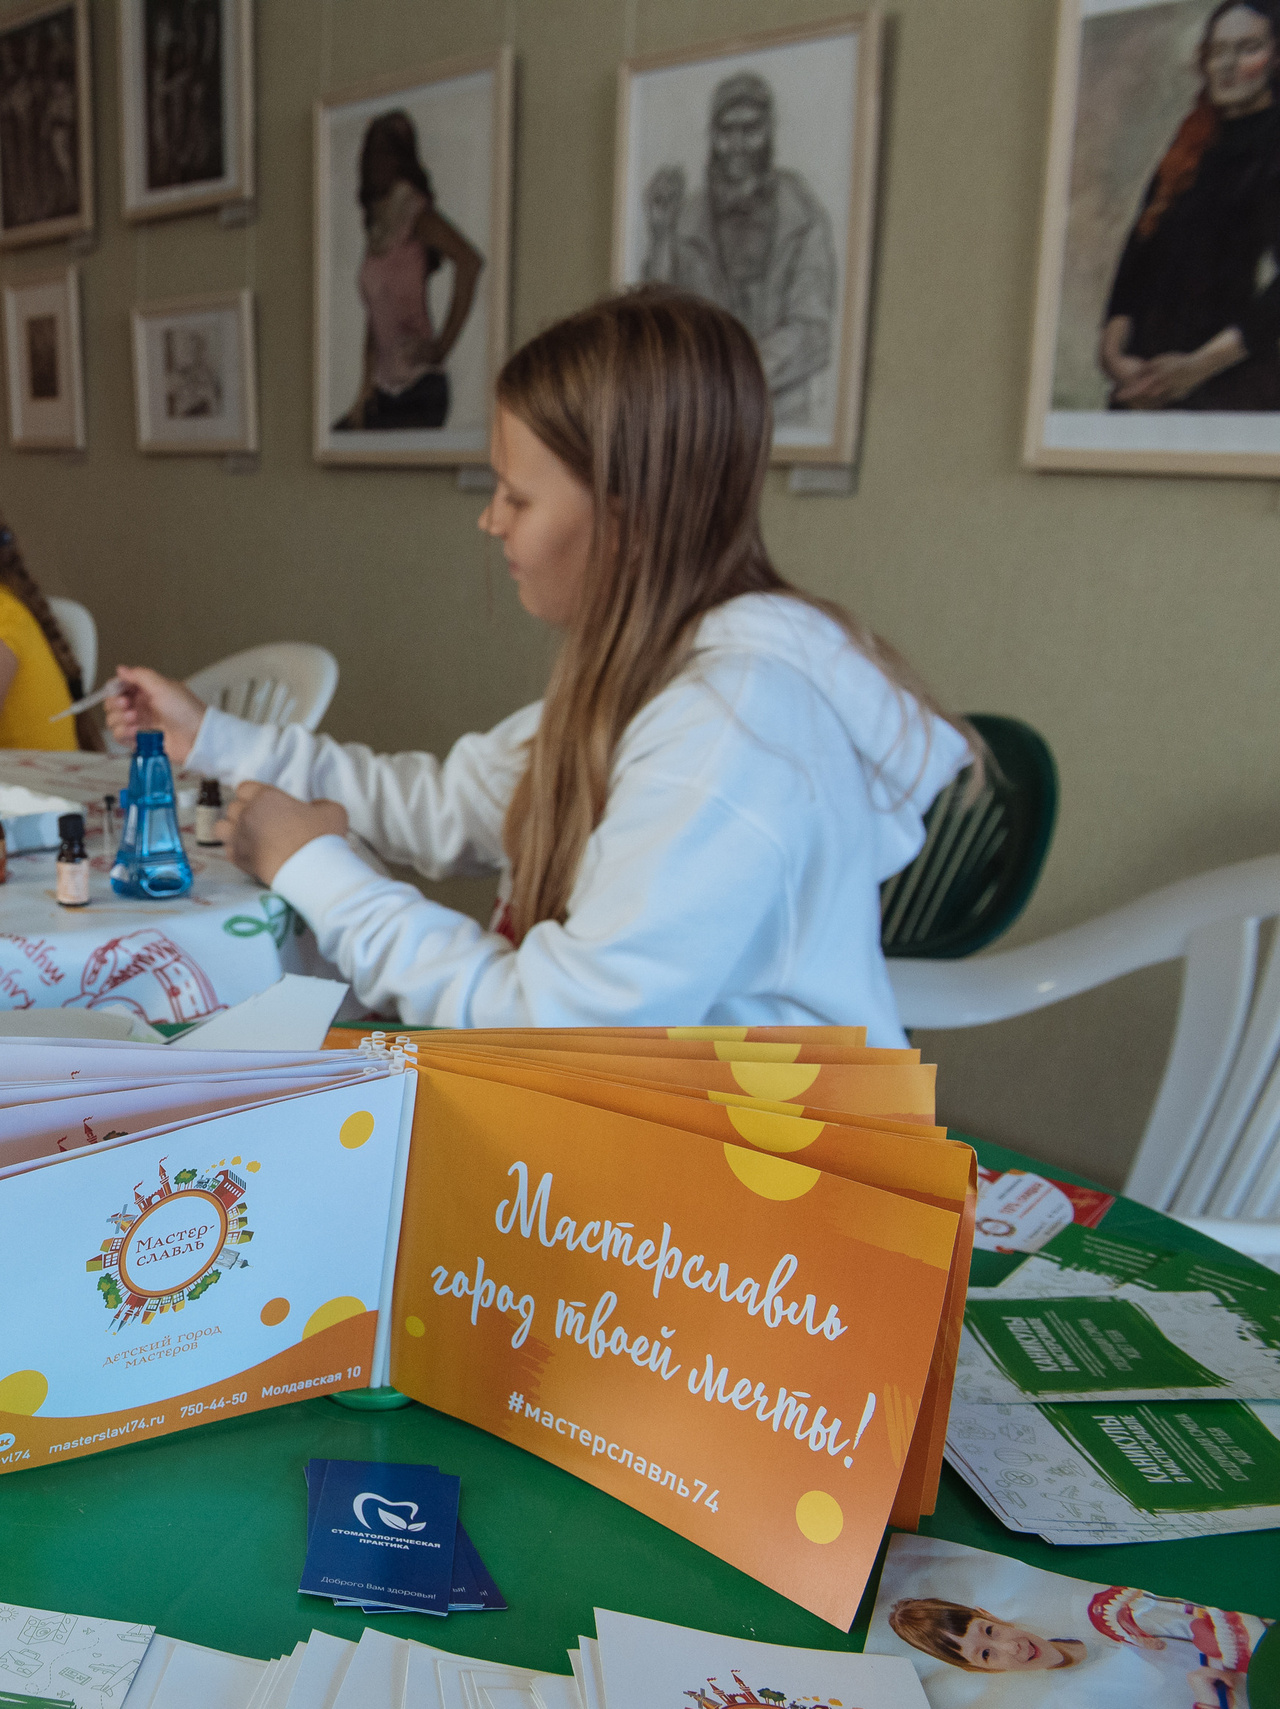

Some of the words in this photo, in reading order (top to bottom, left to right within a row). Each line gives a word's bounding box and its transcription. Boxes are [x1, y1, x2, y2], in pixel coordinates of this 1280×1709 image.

[495, 1160, 848, 1341] Мастерславль
[431, 1256, 535, 1349] город
[555, 1291, 681, 1381] твоей
[48, 1414, 165, 1454] masterslavl74.ru
[180, 1391, 248, 1419] 750-44-50
[261, 1372, 342, 1398] Молдавская
[347, 1365, 361, 1379] 10
[508, 1391, 720, 1514] #мастерславль74
[1091, 1415, 1173, 1483] КАНИКУЛЫ
[331, 1528, 441, 1549] СТОМАТОЛОГИЧЕСКАЯ
[359, 1538, 410, 1550] ПРАКТИКА
[321, 1576, 364, 1588] Доброго
[366, 1583, 385, 1592] Вам
[387, 1587, 436, 1600] здоровья!
